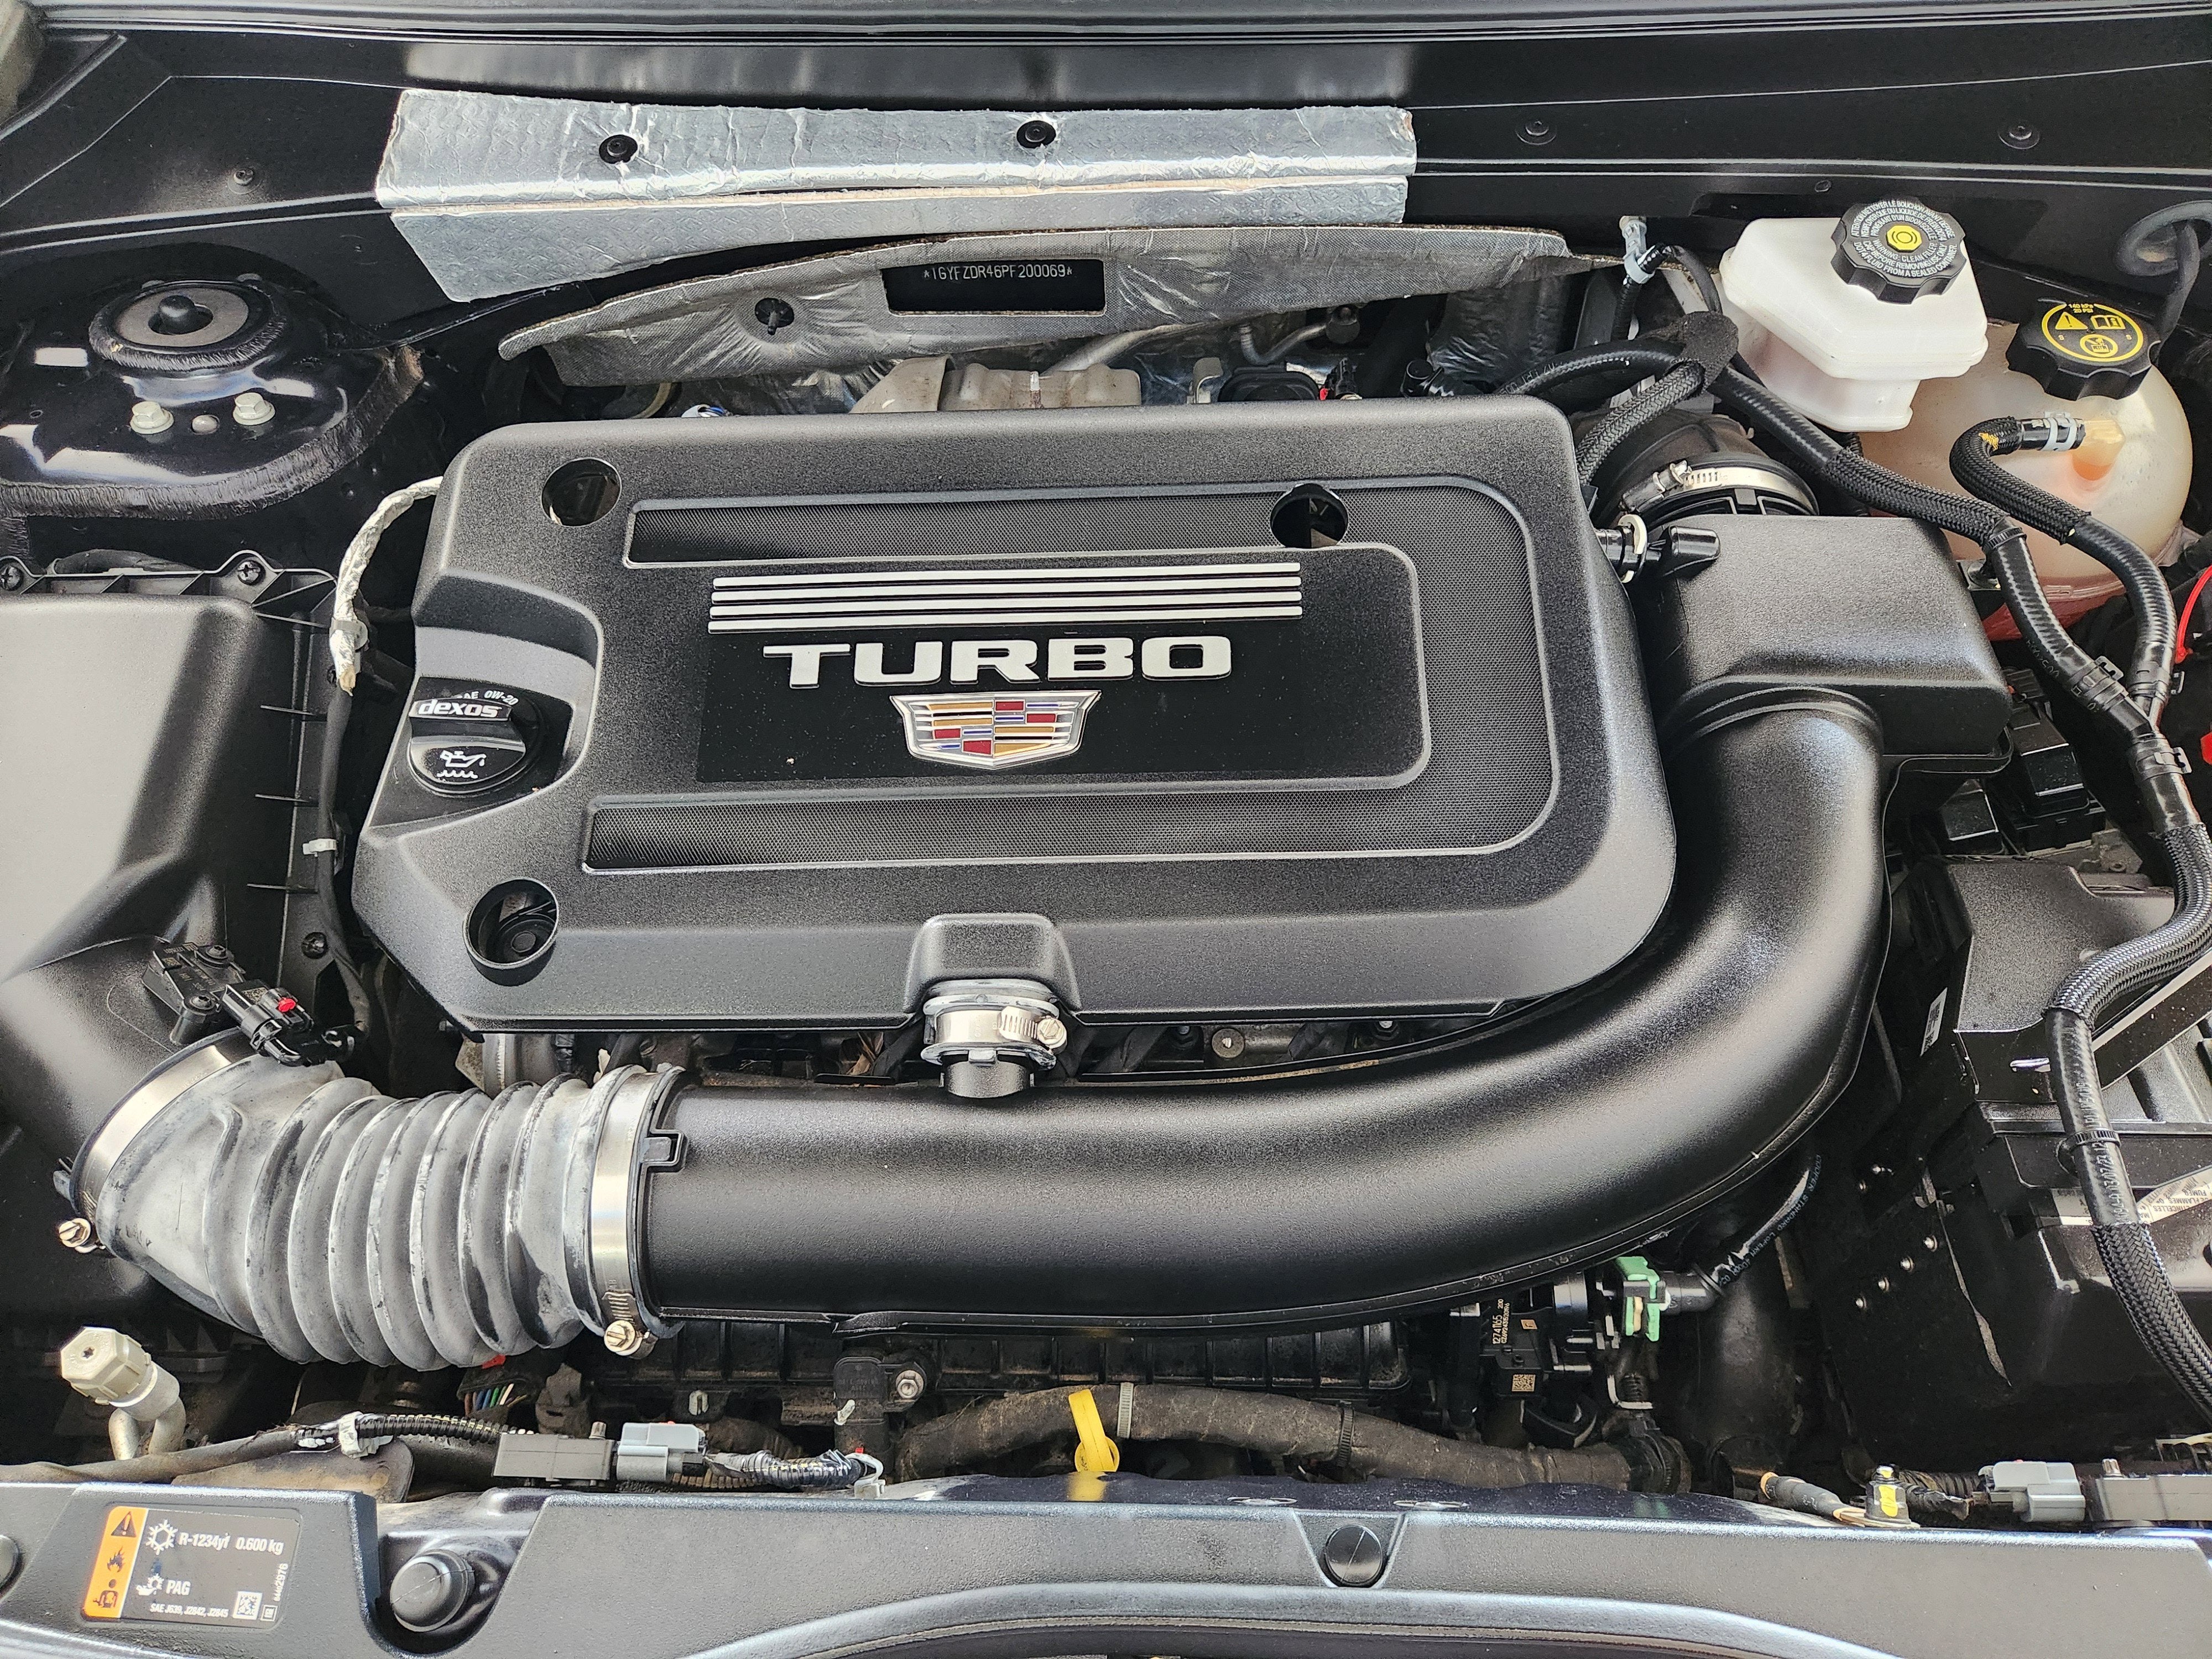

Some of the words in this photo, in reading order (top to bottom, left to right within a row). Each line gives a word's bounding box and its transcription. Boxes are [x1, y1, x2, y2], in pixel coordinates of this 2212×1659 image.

[1895, 207, 1919, 217] LIQUIDE
[1916, 212, 1927, 221] DE
[1923, 216, 1941, 229] FREIN
[1896, 200, 1926, 212] BOUCHON
[1922, 207, 1943, 222] AVANT
[1938, 220, 1956, 238] DEPOSE
[1905, 215, 1923, 226] BIDON
[1862, 240, 1876, 252] CAP
[1870, 249, 1896, 267] BEFORE
[1934, 243, 1948, 257] ONLY
[1901, 254, 1926, 263] CLEAN
[1921, 242, 1938, 258] FILLER
[1862, 254, 1885, 270] FLUID
[1882, 264, 1905, 276] FROM
[1910, 266, 1939, 277] SEALED
[763, 636, 1232, 689] TURBO
[483, 690, 519, 706] 0W-20
[418, 700, 502, 718] dexos
[1777, 1194, 1809, 1231] STANDARD
[235, 1536, 268, 1552] 0.600
[268, 1538, 284, 1556] kg
[165, 1579, 191, 1596] PAG
[150, 1603, 165, 1613] SAE
